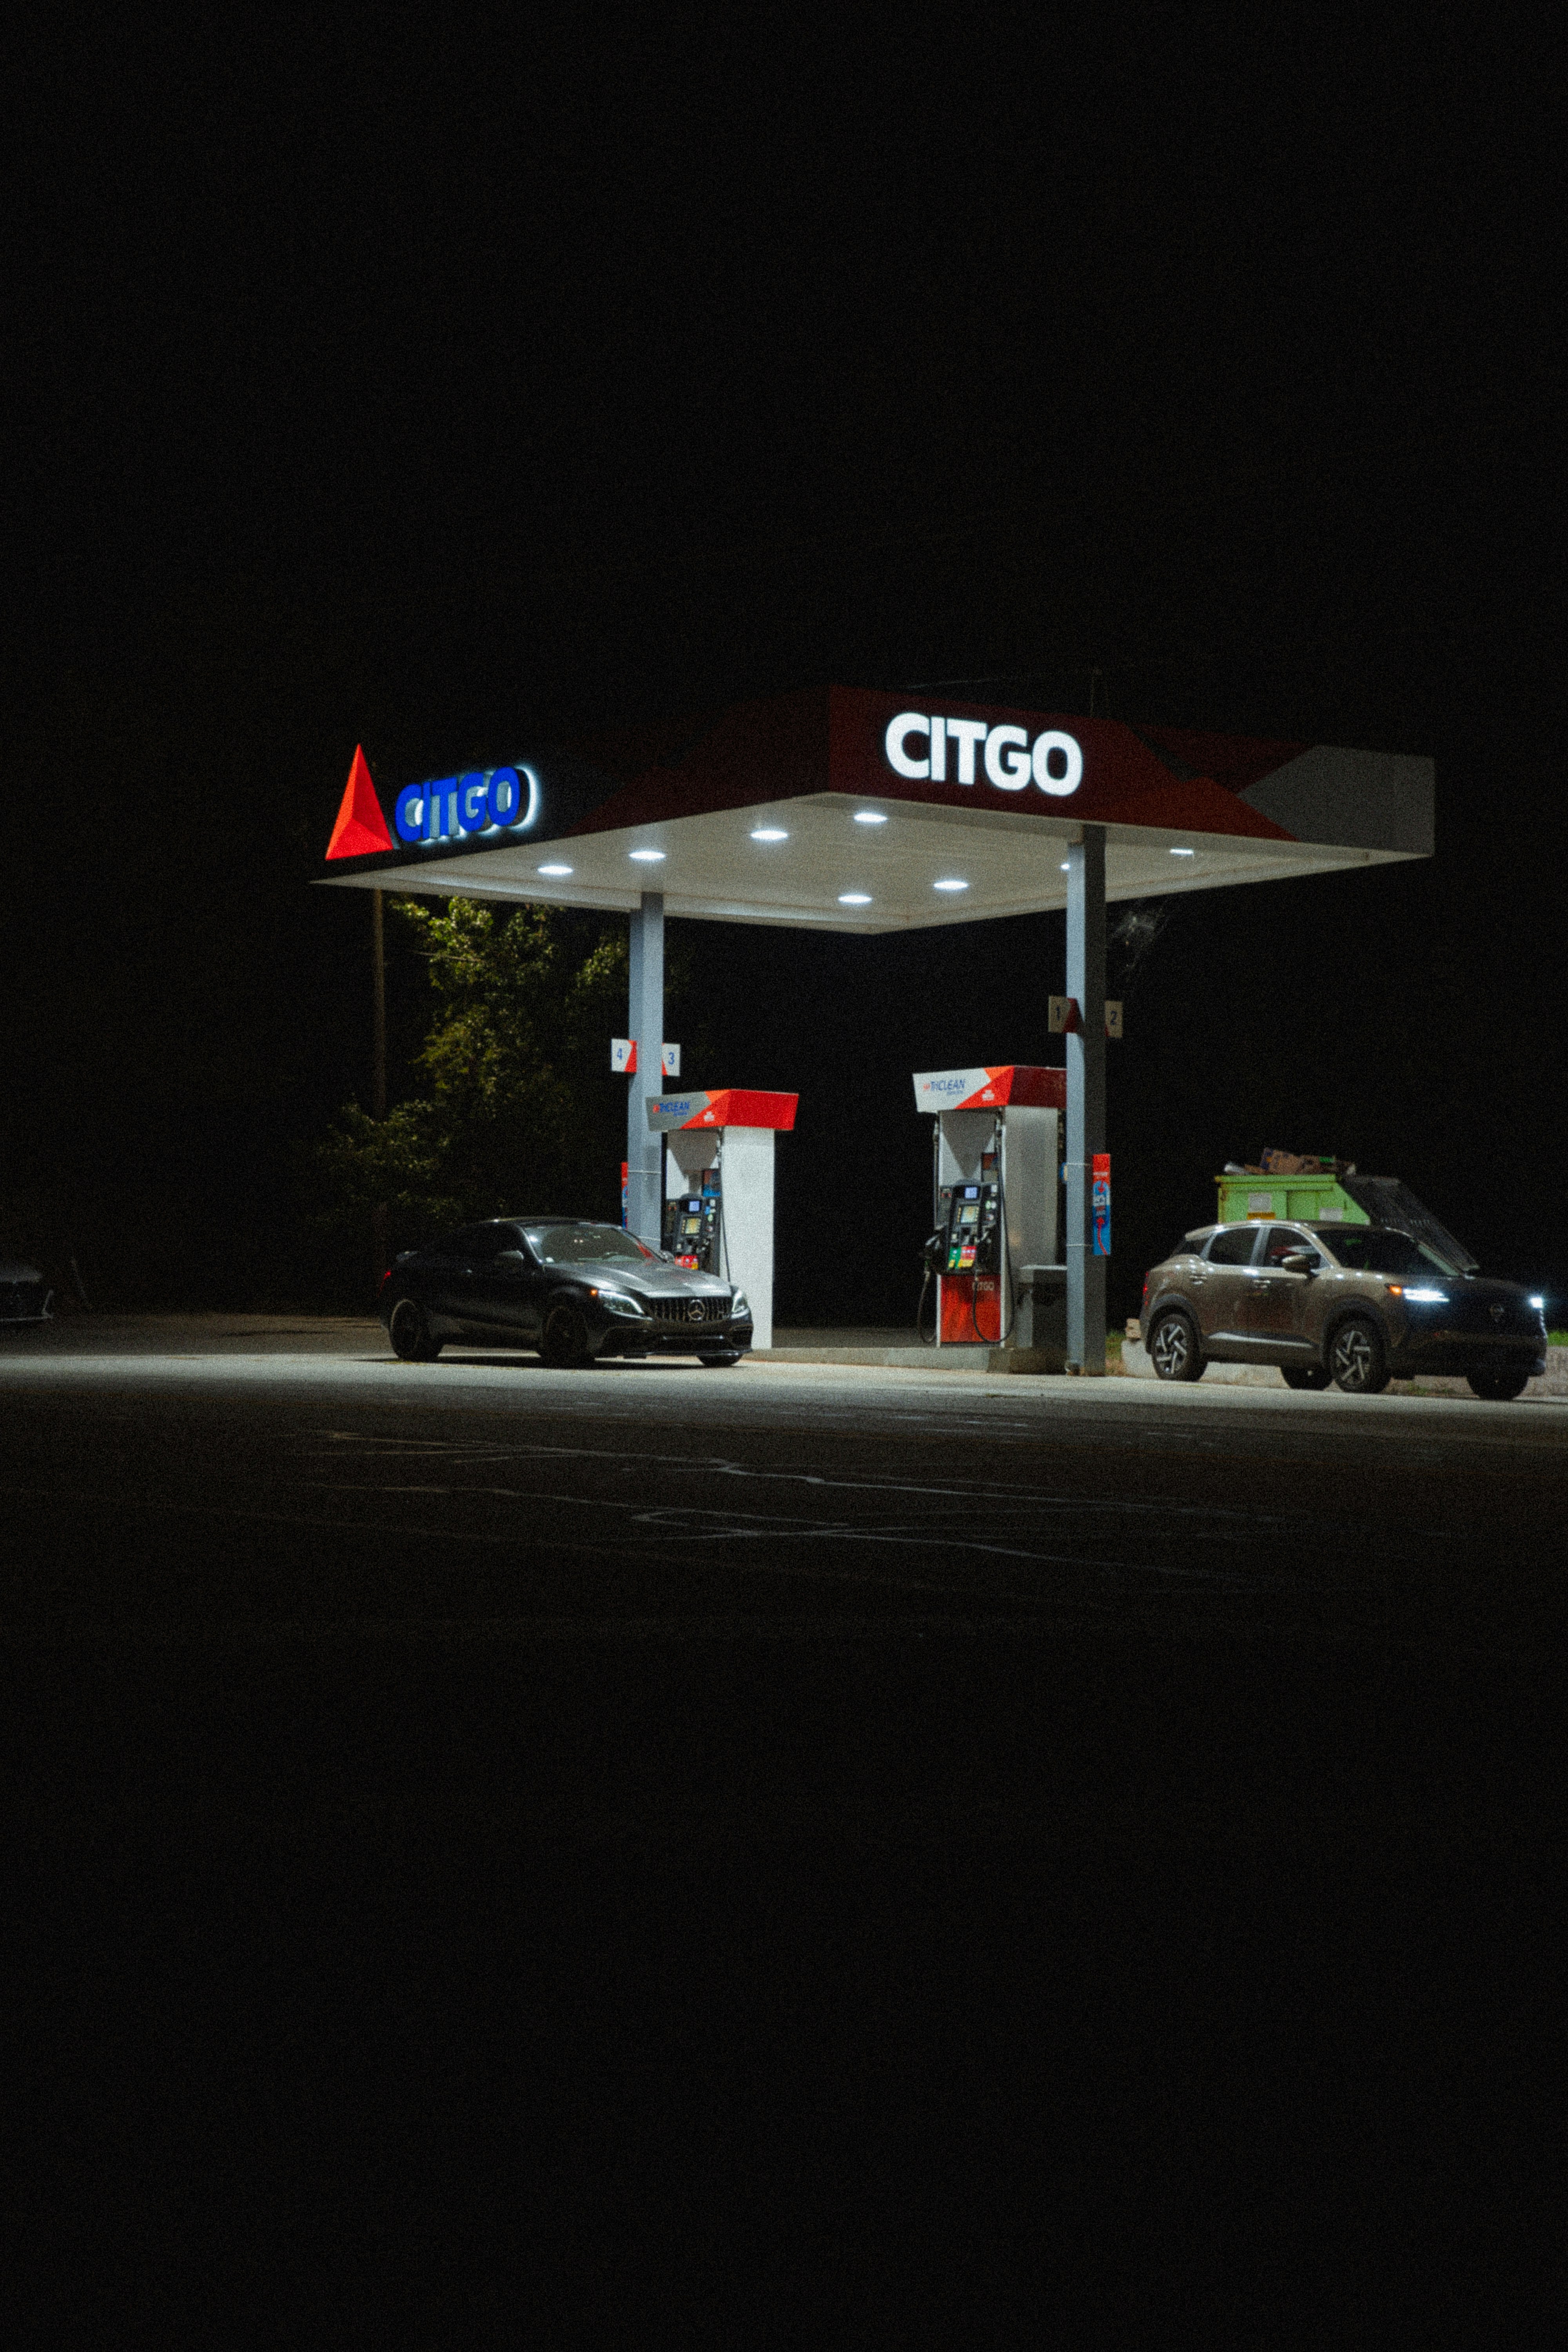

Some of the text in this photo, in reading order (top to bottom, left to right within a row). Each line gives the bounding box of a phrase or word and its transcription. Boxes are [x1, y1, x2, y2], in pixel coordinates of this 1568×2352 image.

[885, 711, 1083, 797] CITGO
[395, 766, 521, 842] CITGO
[1056, 1006, 1061, 1020] 1
[1111, 1011, 1118, 1025] 2
[617, 1048, 622, 1060] 4
[668, 1052, 675, 1065] 3
